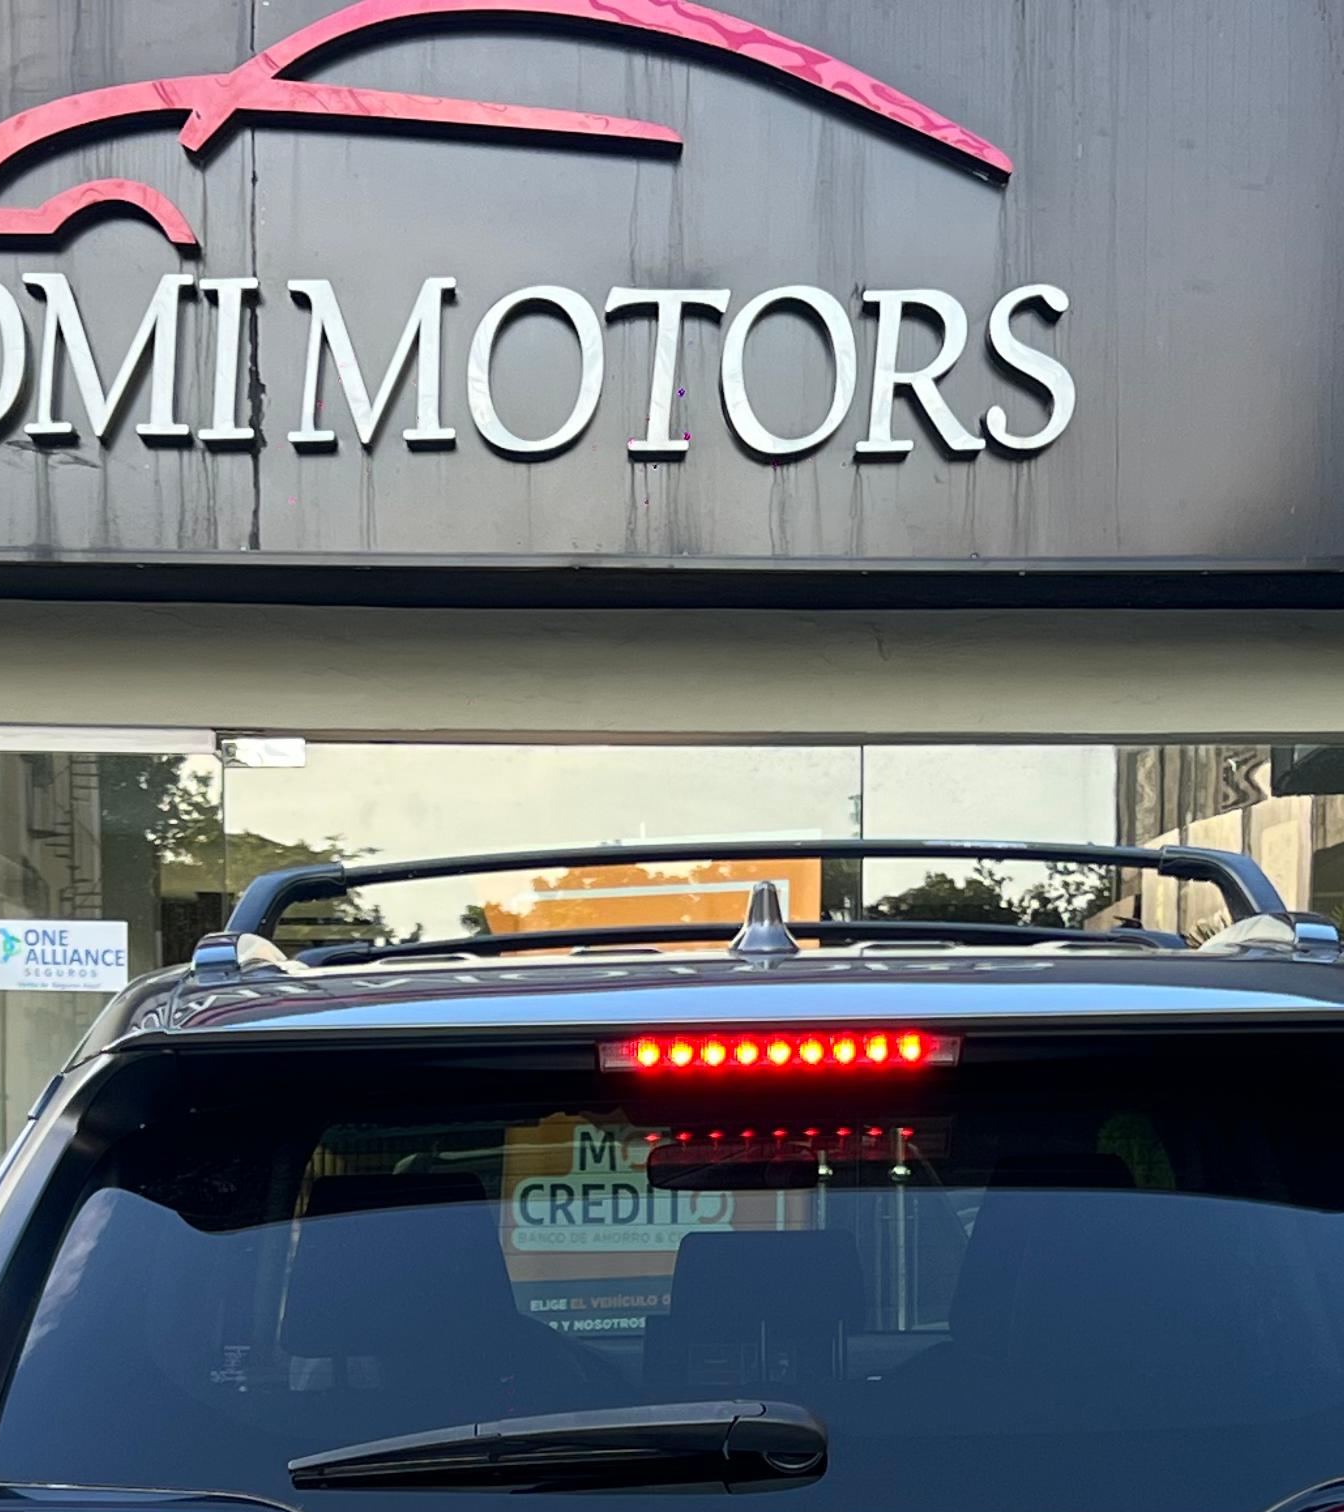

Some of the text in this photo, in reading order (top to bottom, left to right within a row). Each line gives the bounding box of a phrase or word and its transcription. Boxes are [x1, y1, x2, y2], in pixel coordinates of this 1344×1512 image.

[286, 276, 1077, 462] MOTORS
[24, 929, 69, 947] ONE
[24, 948, 125, 967] ALLIANCE
[24, 968, 98, 978] SEGUROS
[519, 1182, 728, 1226] CREDITO
[518, 1231, 565, 1244] BANCO
[570, 1231, 588, 1244] DE
[593, 1231, 652, 1244] AHORRO
[529, 1299, 568, 1313] ELIGE
[570, 1298, 588, 1310] EL
[561, 1320, 571, 1331] Y
[573, 1316, 647, 1331] NOSOTROS
